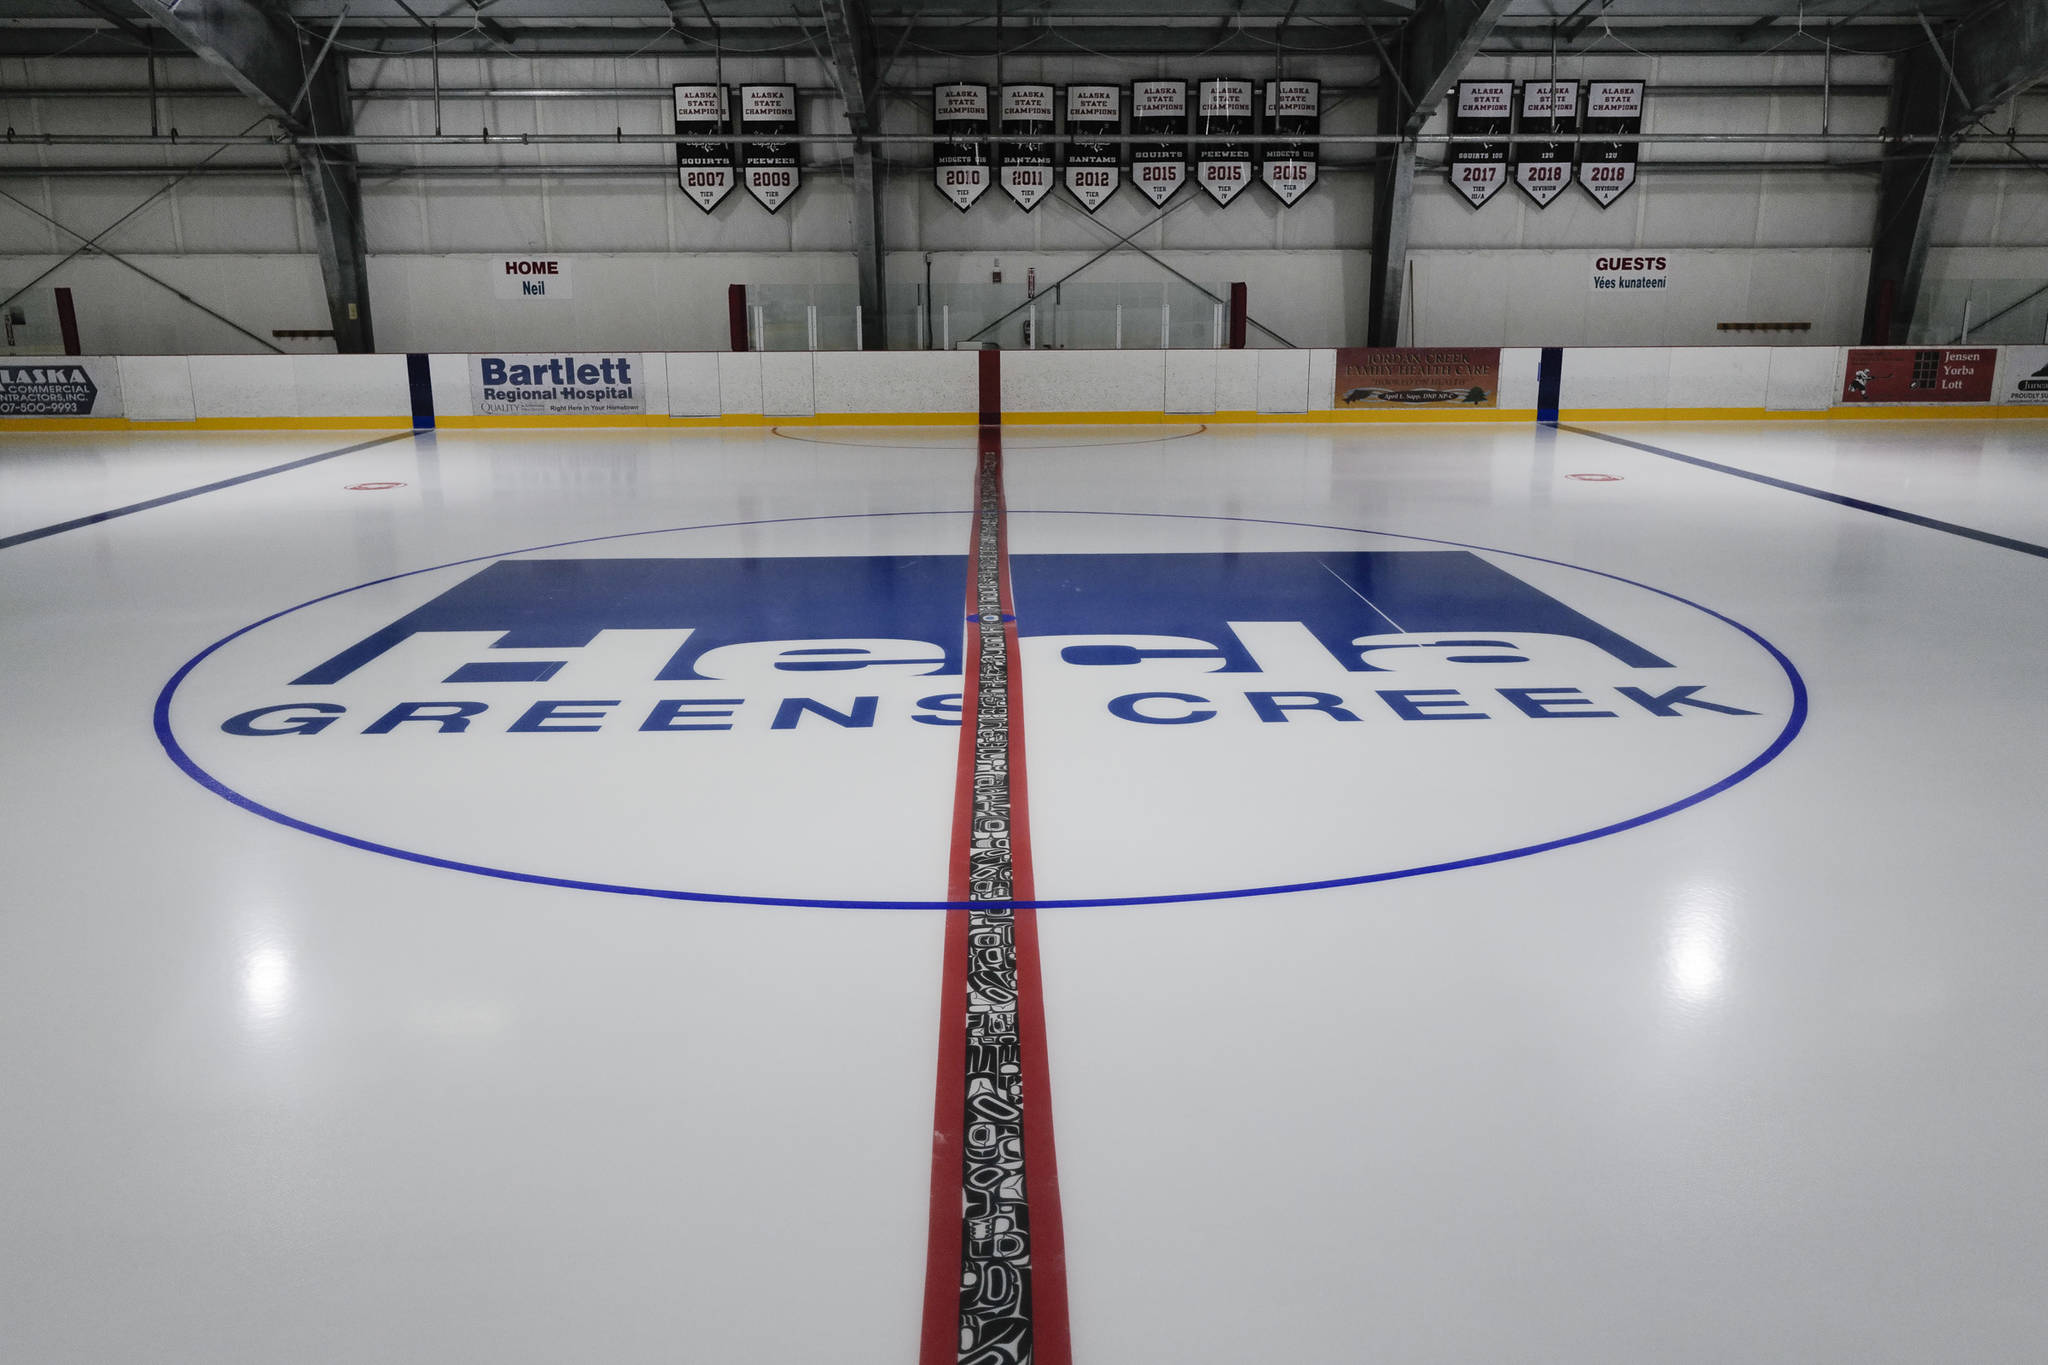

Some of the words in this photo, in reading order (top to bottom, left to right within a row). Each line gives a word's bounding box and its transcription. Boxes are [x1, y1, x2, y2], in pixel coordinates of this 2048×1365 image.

[688, 172, 725, 186] 2007
[753, 172, 790, 186] 2009
[946, 170, 980, 185] 2010
[1012, 171, 1043, 185] 2011
[1075, 172, 1109, 186] 2012
[1143, 166, 1177, 181] 2015
[1207, 166, 1241, 180] 2015
[1273, 166, 1307, 180] 2015
[1463, 167, 1496, 181] 2017
[1528, 167, 1562, 181] 2018
[1591, 167, 1625, 181] 2018
[505, 262, 559, 274] HOME
[1596, 257, 1667, 270] GUESTS
[522, 281, 545, 295] Neil
[1594, 276, 1616, 288] Yées
[1368, 353, 1422, 365] JORDAN
[1426, 353, 1470, 364] CREEK
[1944, 352, 1980, 363] Jensen
[0, 369, 86, 384] LASKA
[481, 358, 631, 385] Bartlett
[1346, 366, 1396, 376] FAMILY
[1399, 366, 1451, 376] HEALTH
[1455, 366, 1490, 376] CARE
[1943, 366, 1975, 376] Yorba
[8, 385, 90, 393] COMMERCIAL
[1941, 380, 1962, 389] Lott
[484, 388, 557, 402] Regional
[560, 387, 633, 402] Hospital
[0, 403, 77, 412] 07-500-9993
[220, 692, 963, 734] GREENS
[1106, 685, 1763, 724] CREEK
